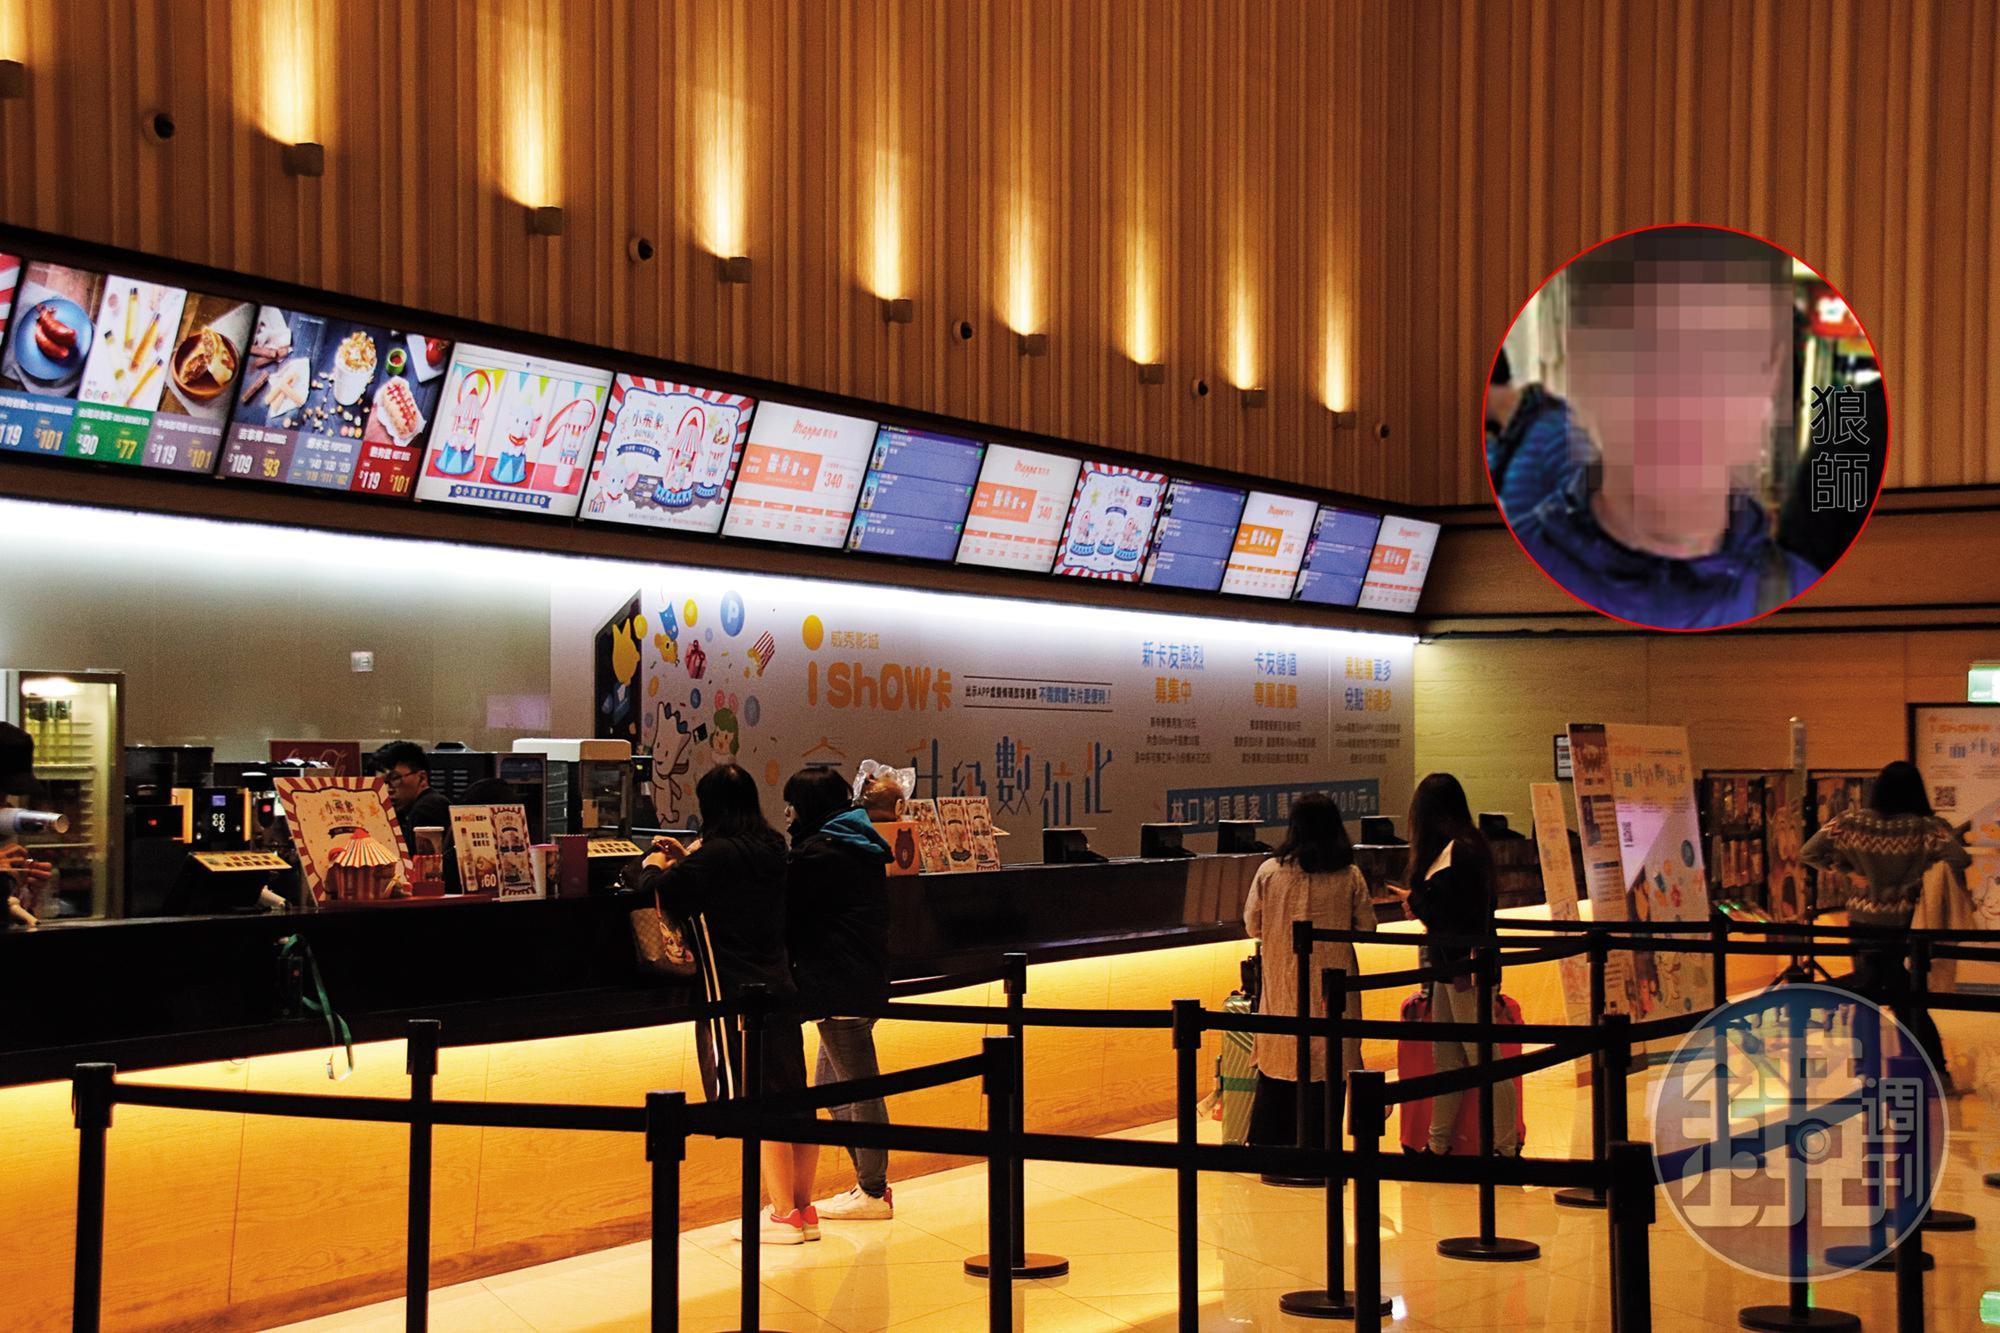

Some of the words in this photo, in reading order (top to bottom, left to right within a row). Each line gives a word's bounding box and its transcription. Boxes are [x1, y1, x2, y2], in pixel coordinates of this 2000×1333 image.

[34, 426, 63, 451] $101
[77, 433, 99, 455] $90
[116, 438, 138, 460] $77
[151, 444, 178, 466] $119
[188, 449, 213, 469] $101
[228, 454, 254, 475] $109
[262, 457, 281, 478] $93
[359, 470, 381, 491] $119
[389, 474, 411, 494] $101
